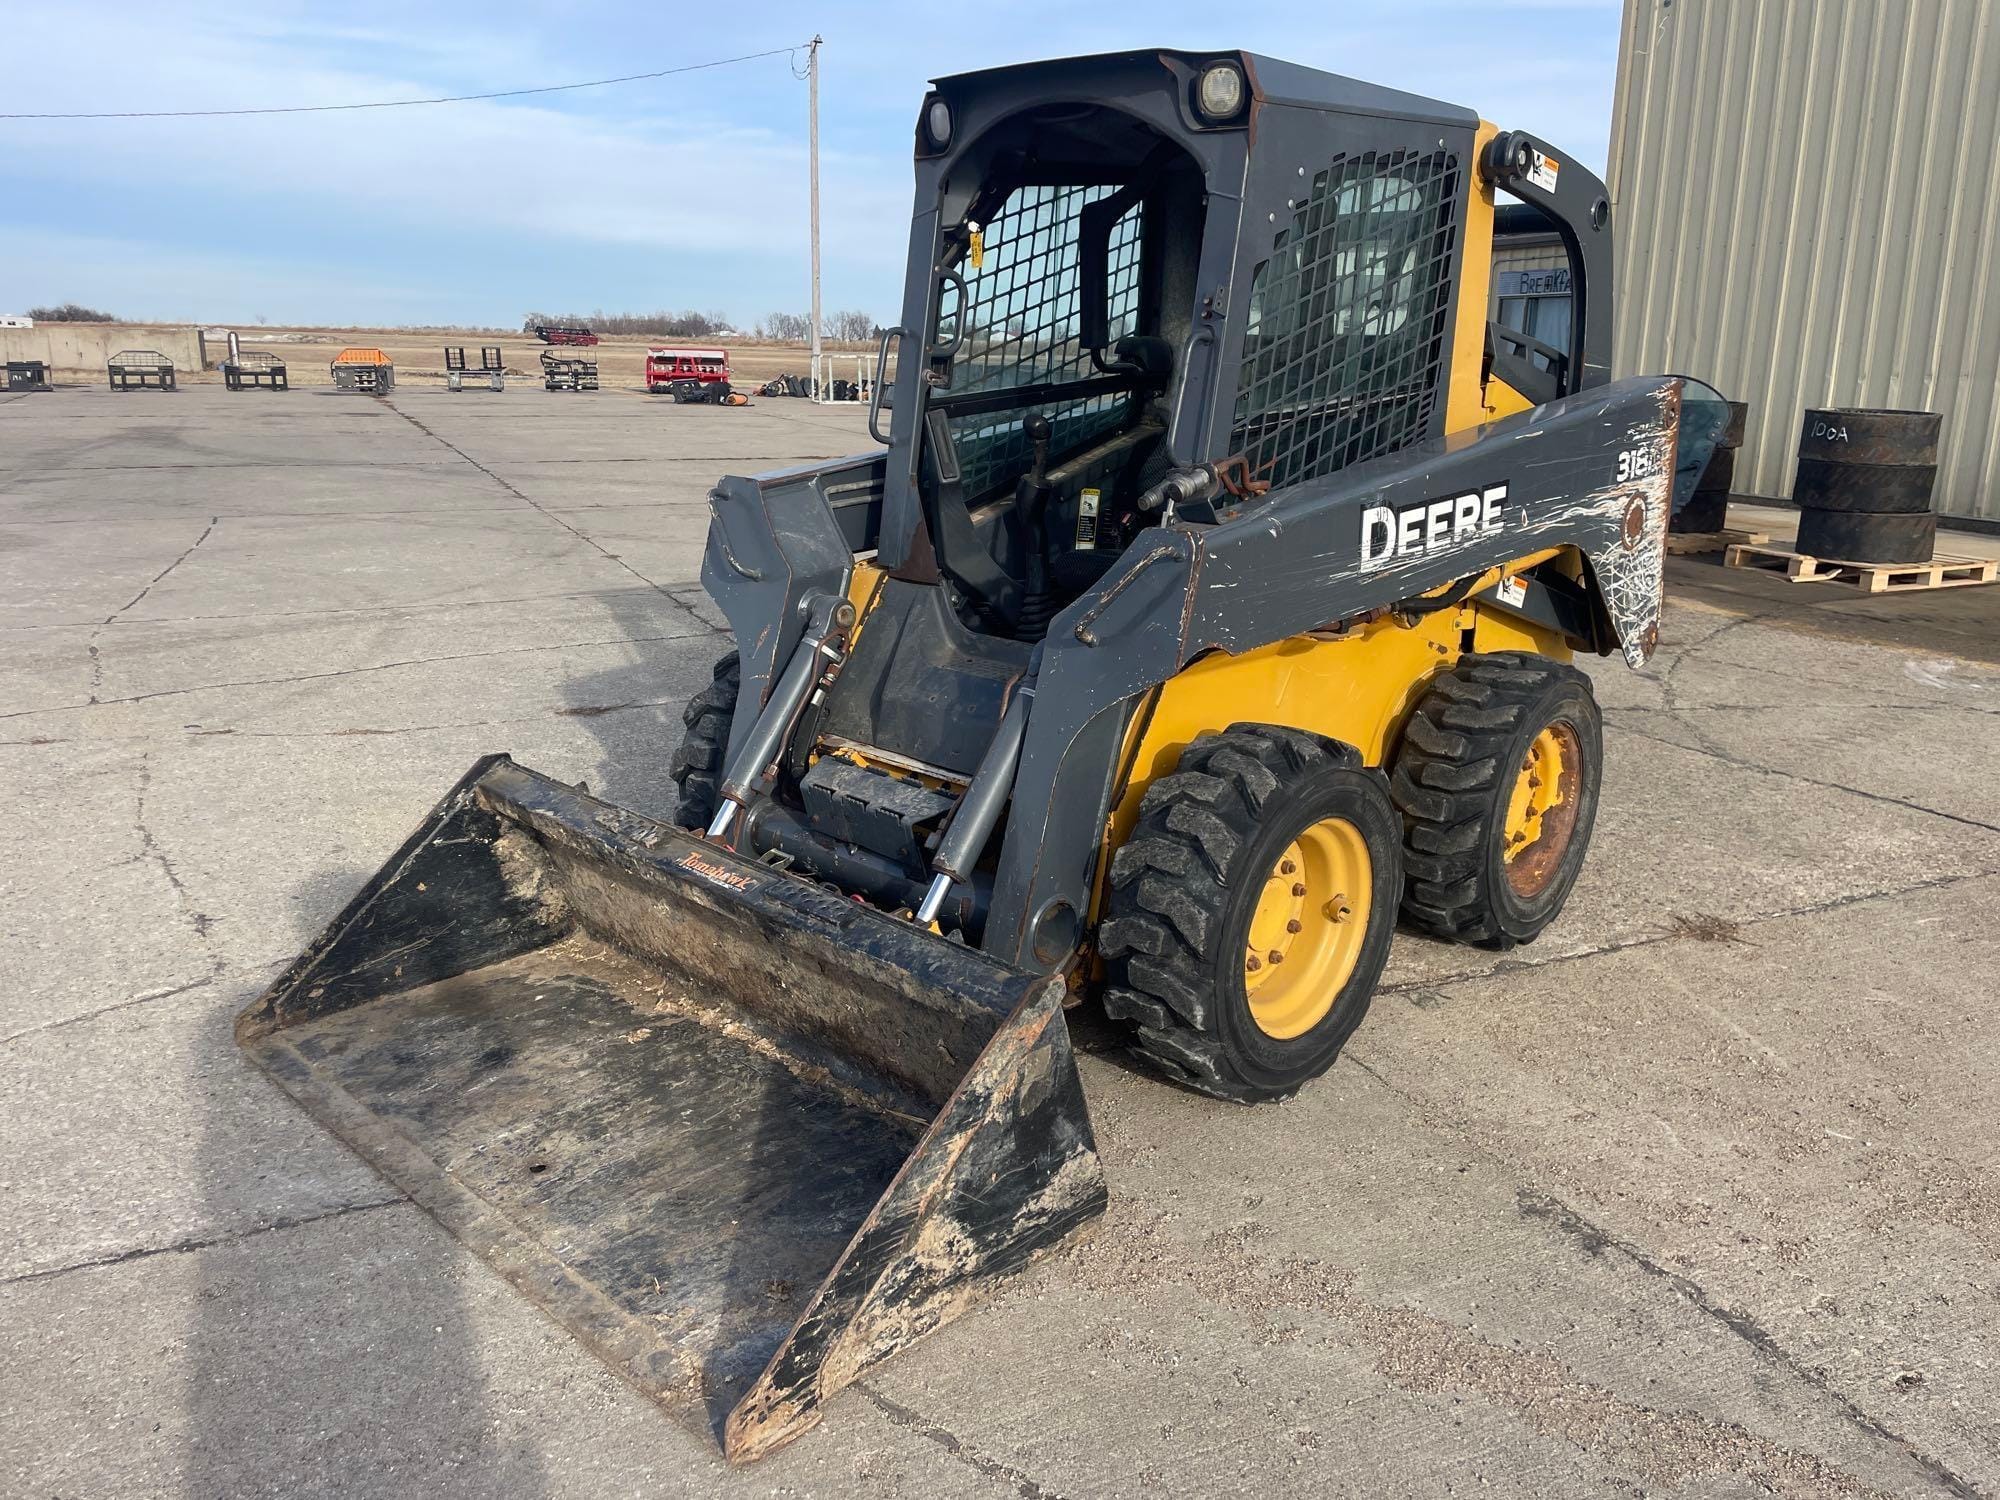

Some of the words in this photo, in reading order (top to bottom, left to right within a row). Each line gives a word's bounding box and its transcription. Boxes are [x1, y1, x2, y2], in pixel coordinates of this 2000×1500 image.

[1616, 447, 1655, 482] 318
[1359, 485, 1507, 573] DEERE
[678, 852, 753, 890] Tomahawk
